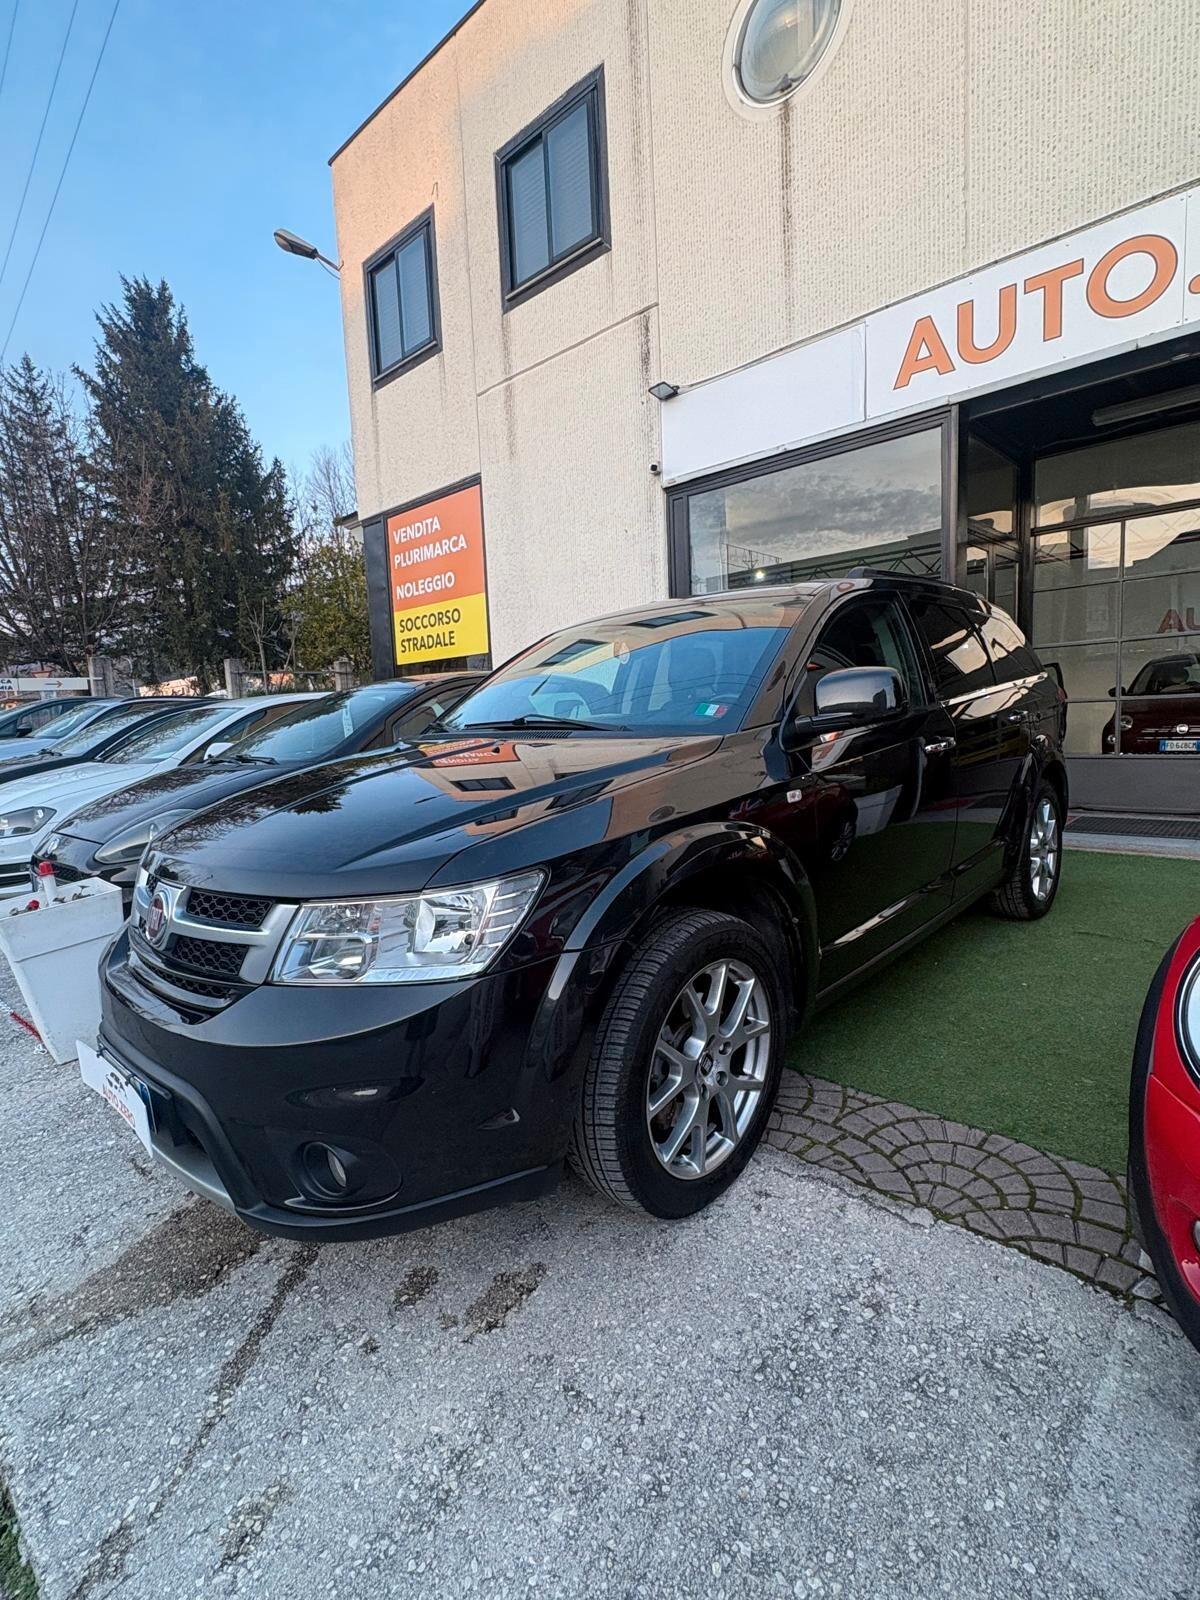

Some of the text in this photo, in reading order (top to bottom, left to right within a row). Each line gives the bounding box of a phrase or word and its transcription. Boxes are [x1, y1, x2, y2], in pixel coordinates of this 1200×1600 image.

[393, 515, 441, 545] VENDITA
[394, 534, 468, 570] PLURIMARCA
[396, 571, 456, 600] NOLEGGIO
[399, 608, 461, 634] SOCCORSO
[400, 630, 455, 654] STRADALE
